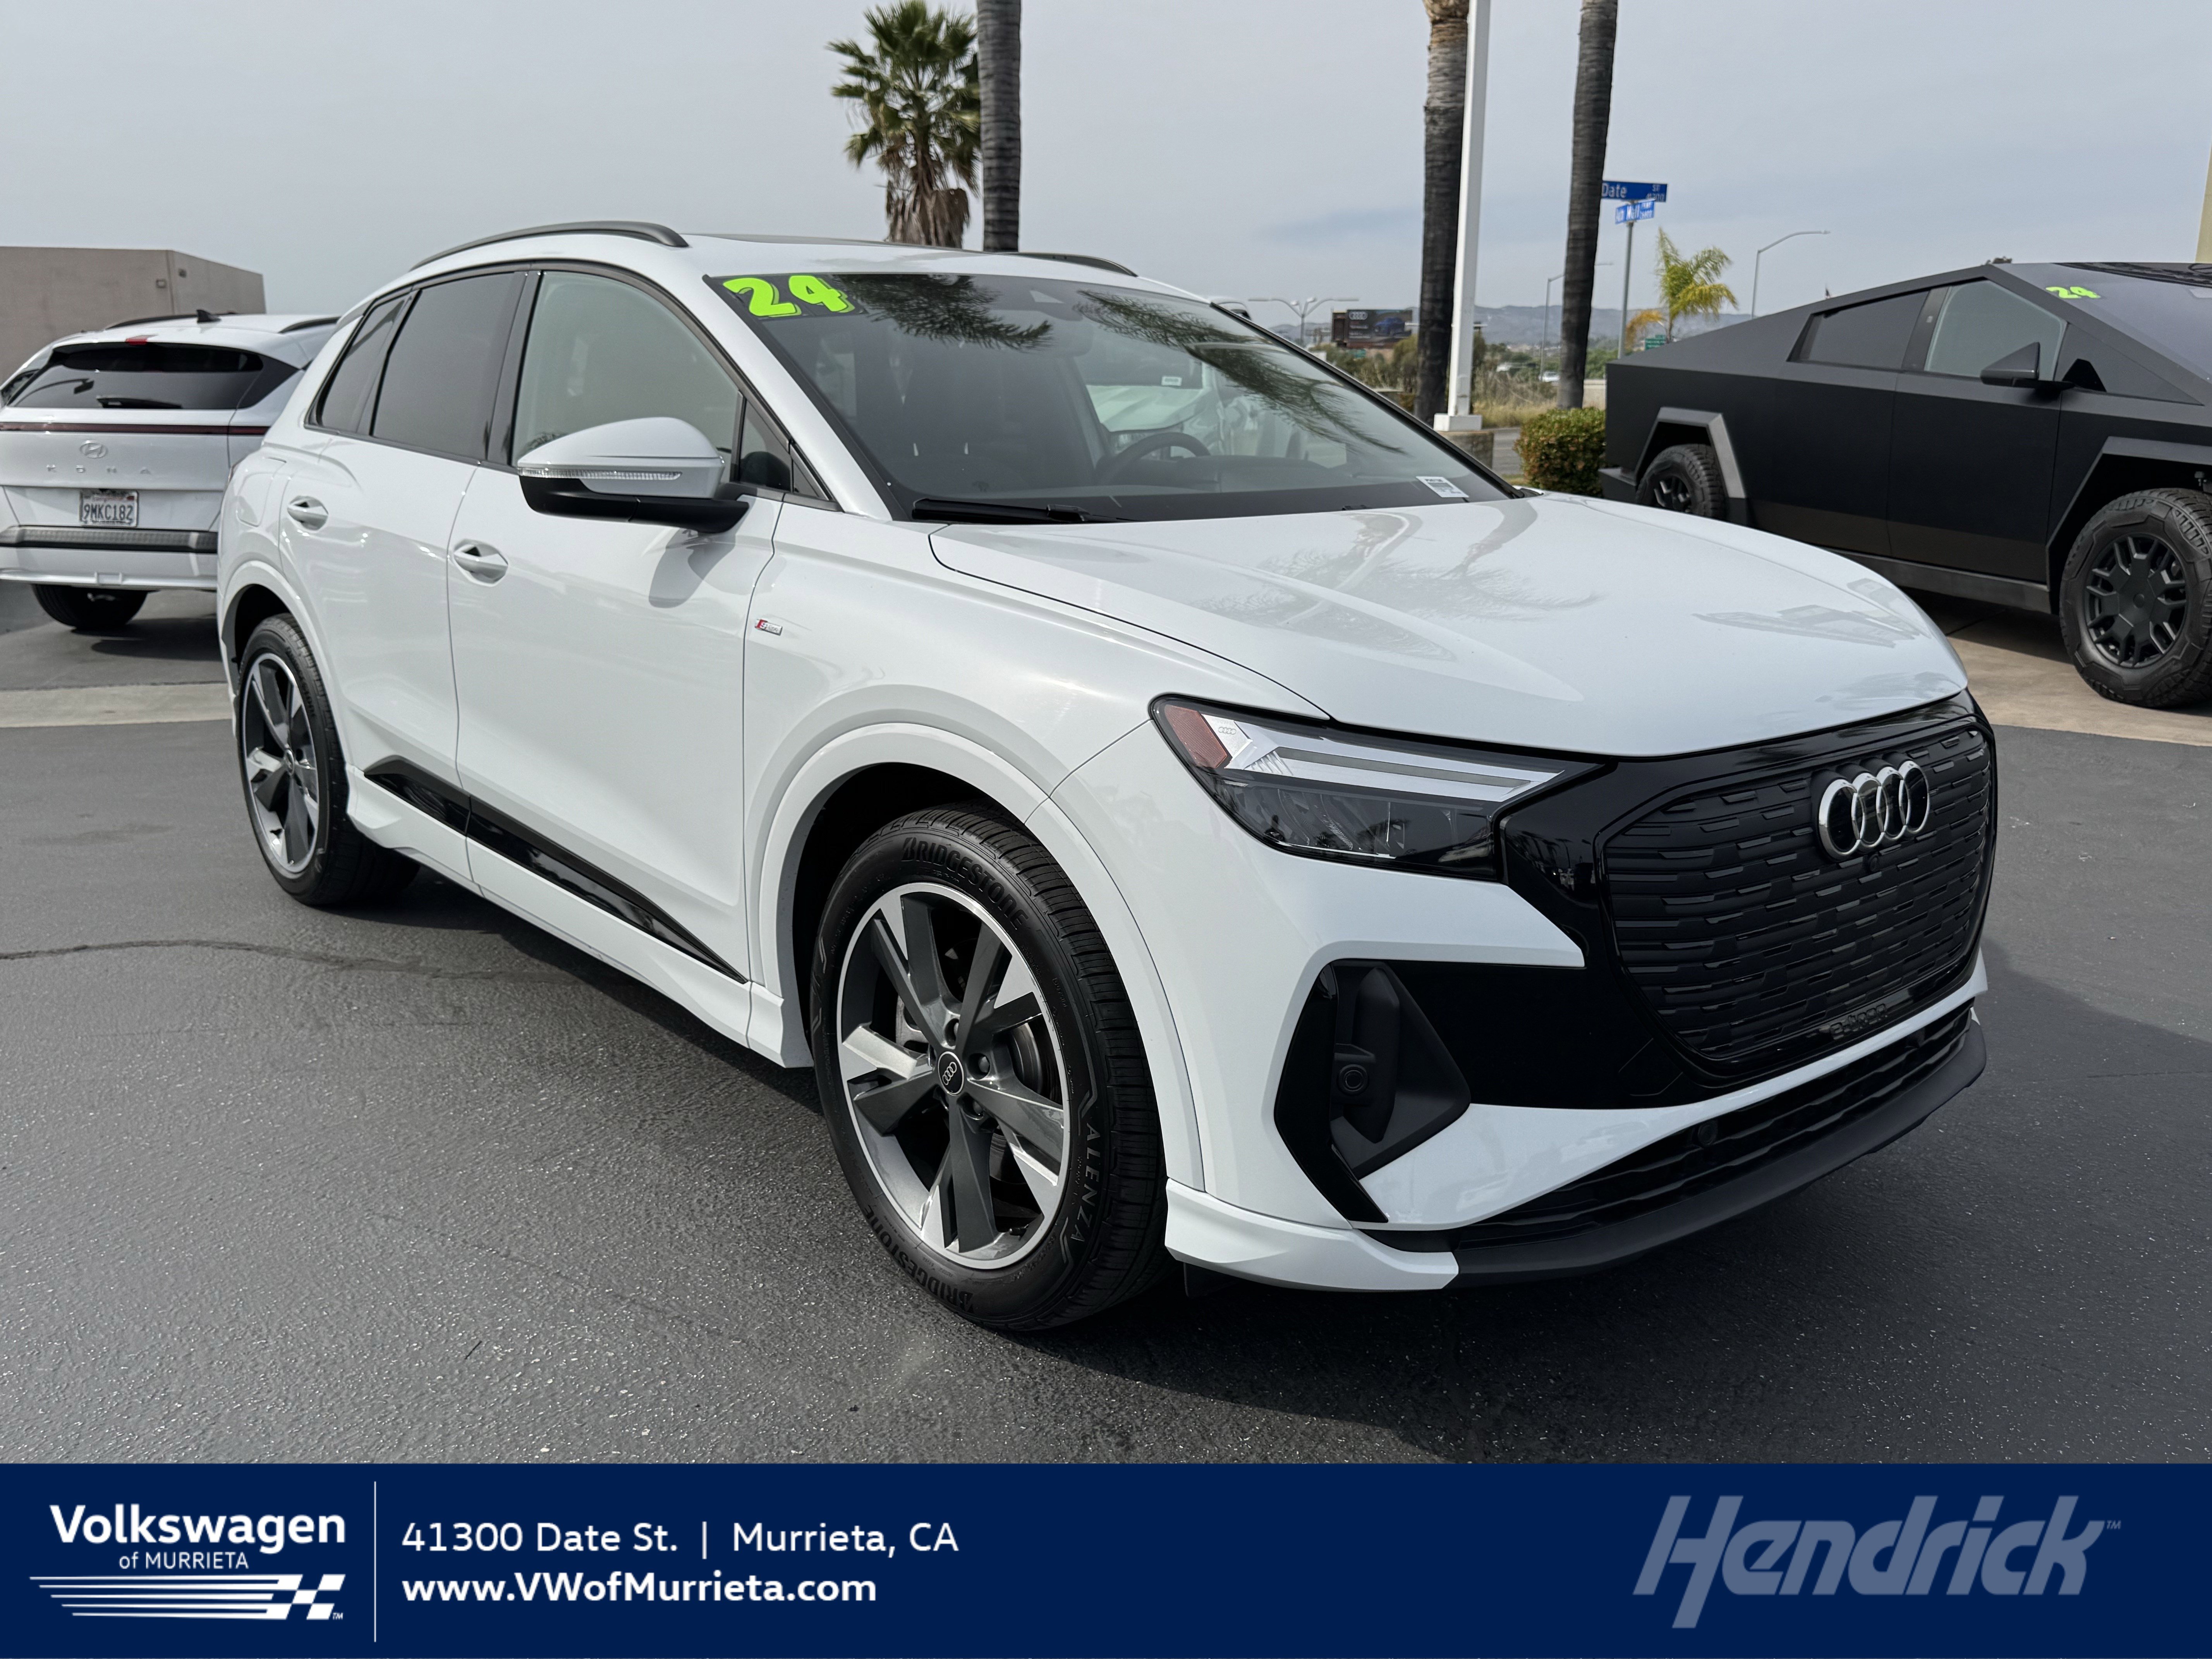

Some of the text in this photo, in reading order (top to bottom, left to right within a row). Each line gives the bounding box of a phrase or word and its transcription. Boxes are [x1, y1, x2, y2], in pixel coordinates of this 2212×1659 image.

[1602, 182, 1626, 198] Date
[723, 275, 855, 317] 24
[2045, 287, 2101, 298] 24
[84, 503, 133, 521] 9MKC182
[901, 837, 1029, 930] BRIDGESTONE
[1070, 1122, 1101, 1242] ALENZA
[863, 1204, 974, 1313] BRIDGESTONE
